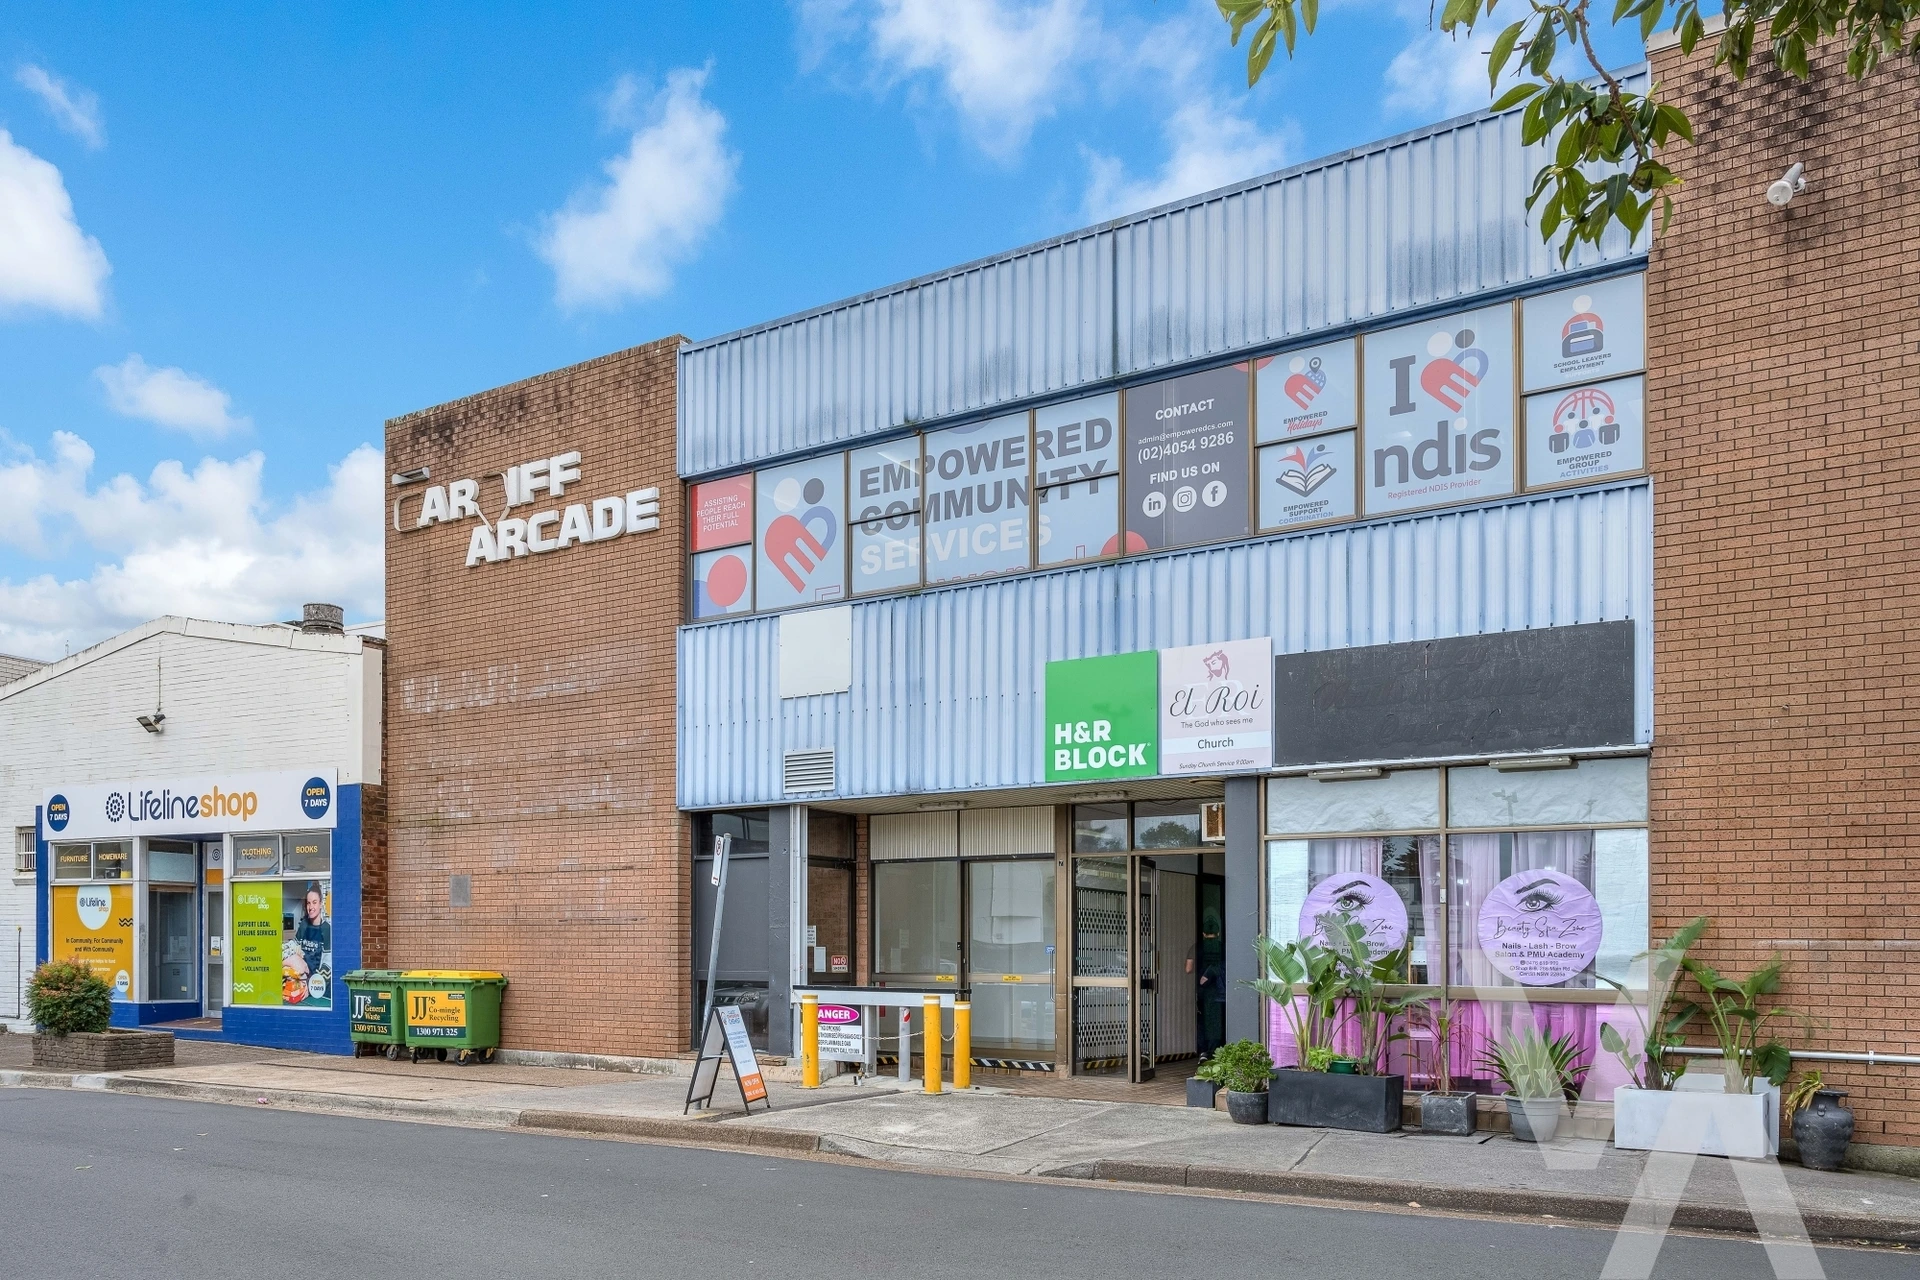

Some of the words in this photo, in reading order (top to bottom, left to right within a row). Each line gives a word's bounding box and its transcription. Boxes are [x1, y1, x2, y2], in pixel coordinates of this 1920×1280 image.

[1554, 359, 1580, 369] SCHOOL
[1581, 352, 1612, 363] LEAVERS
[1560, 360, 1605, 374] EMPLOYMENT
[1390, 355, 1416, 416] I
[1155, 399, 1214, 420] CONTACT
[1283, 410, 1328, 425] EMPOWERED
[1138, 420, 1234, 445] admin@empoweredcs.com
[1287, 418, 1323, 434] Holidays
[1138, 438, 1196, 464] (02)4054
[1200, 431, 1234, 450] 9286
[1374, 417, 1501, 487] ndis
[860, 417, 1112, 498] EMPOWERED
[1557, 450, 1612, 466] EMPOWERED
[1560, 464, 1609, 478] ACTIVITIES
[1569, 459, 1600, 470] GROUP
[1150, 470, 1177, 484] FIND
[1181, 466, 1198, 479] US
[1202, 462, 1220, 475] ON
[1388, 487, 1427, 500] Registered
[1429, 482, 1449, 493] NDIS
[1450, 478, 1482, 489] Provider
[704, 495, 738, 507] ASSISTING
[860, 459, 1108, 536] COMMUNITY
[697, 506, 722, 517] PEOPLE
[723, 501, 746, 511] REACH
[1283, 499, 1329, 512] EMPOWERED
[1289, 506, 1323, 517] SUPPORT
[703, 514, 722, 525] THEIR
[723, 511, 739, 520] FULL
[1279, 511, 1334, 525] COORDINATION
[465, 486, 659, 567] ARCADE
[703, 520, 738, 532] POTENTIAL
[860, 514, 1052, 575] SERVICES
[1170, 688, 1196, 717] El
[1205, 684, 1264, 715] Roi
[1181, 721, 1193, 729] The
[1194, 720, 1209, 728] God
[1210, 719, 1224, 727] who
[1054, 720, 1112, 745] H&R
[1197, 737, 1234, 750] Church
[1179, 762, 1197, 770] Sunday
[1198, 761, 1216, 769] Church
[306, 787, 325, 796] OPEN
[304, 799, 308, 807] 7
[310, 798, 327, 807] DAYS
[54, 813, 68, 821] DAYS
[242, 847, 272, 856] CLOTHING
[295, 846, 318, 854] BOOKS
[60, 855, 88, 863] FURNITURE
[98, 853, 127, 861] HOMEWARE
[86, 898, 106, 908] Lifeline
[244, 894, 266, 905] Lifeline
[1369, 919, 1393, 936] Zone
[1494, 917, 1530, 939] Beauty
[1535, 916, 1558, 937] Spa
[1558, 919, 1586, 938] Zone
[101, 937, 123, 945] Community
[834, 957, 840, 965] NO
[1547, 951, 1584, 960] Academy
[365, 1004, 386, 1013] General
[428, 1006, 460, 1015] Co-mingle
[818, 1009, 851, 1020] ANGER
[365, 1012, 380, 1021] Waste
[429, 1014, 459, 1023] Recycling
[354, 1024, 366, 1032] 1300
[376, 1026, 387, 1034] 325
[416, 1028, 431, 1036] 1300
[432, 1028, 444, 1036] 971
[445, 1028, 458, 1036] 325
